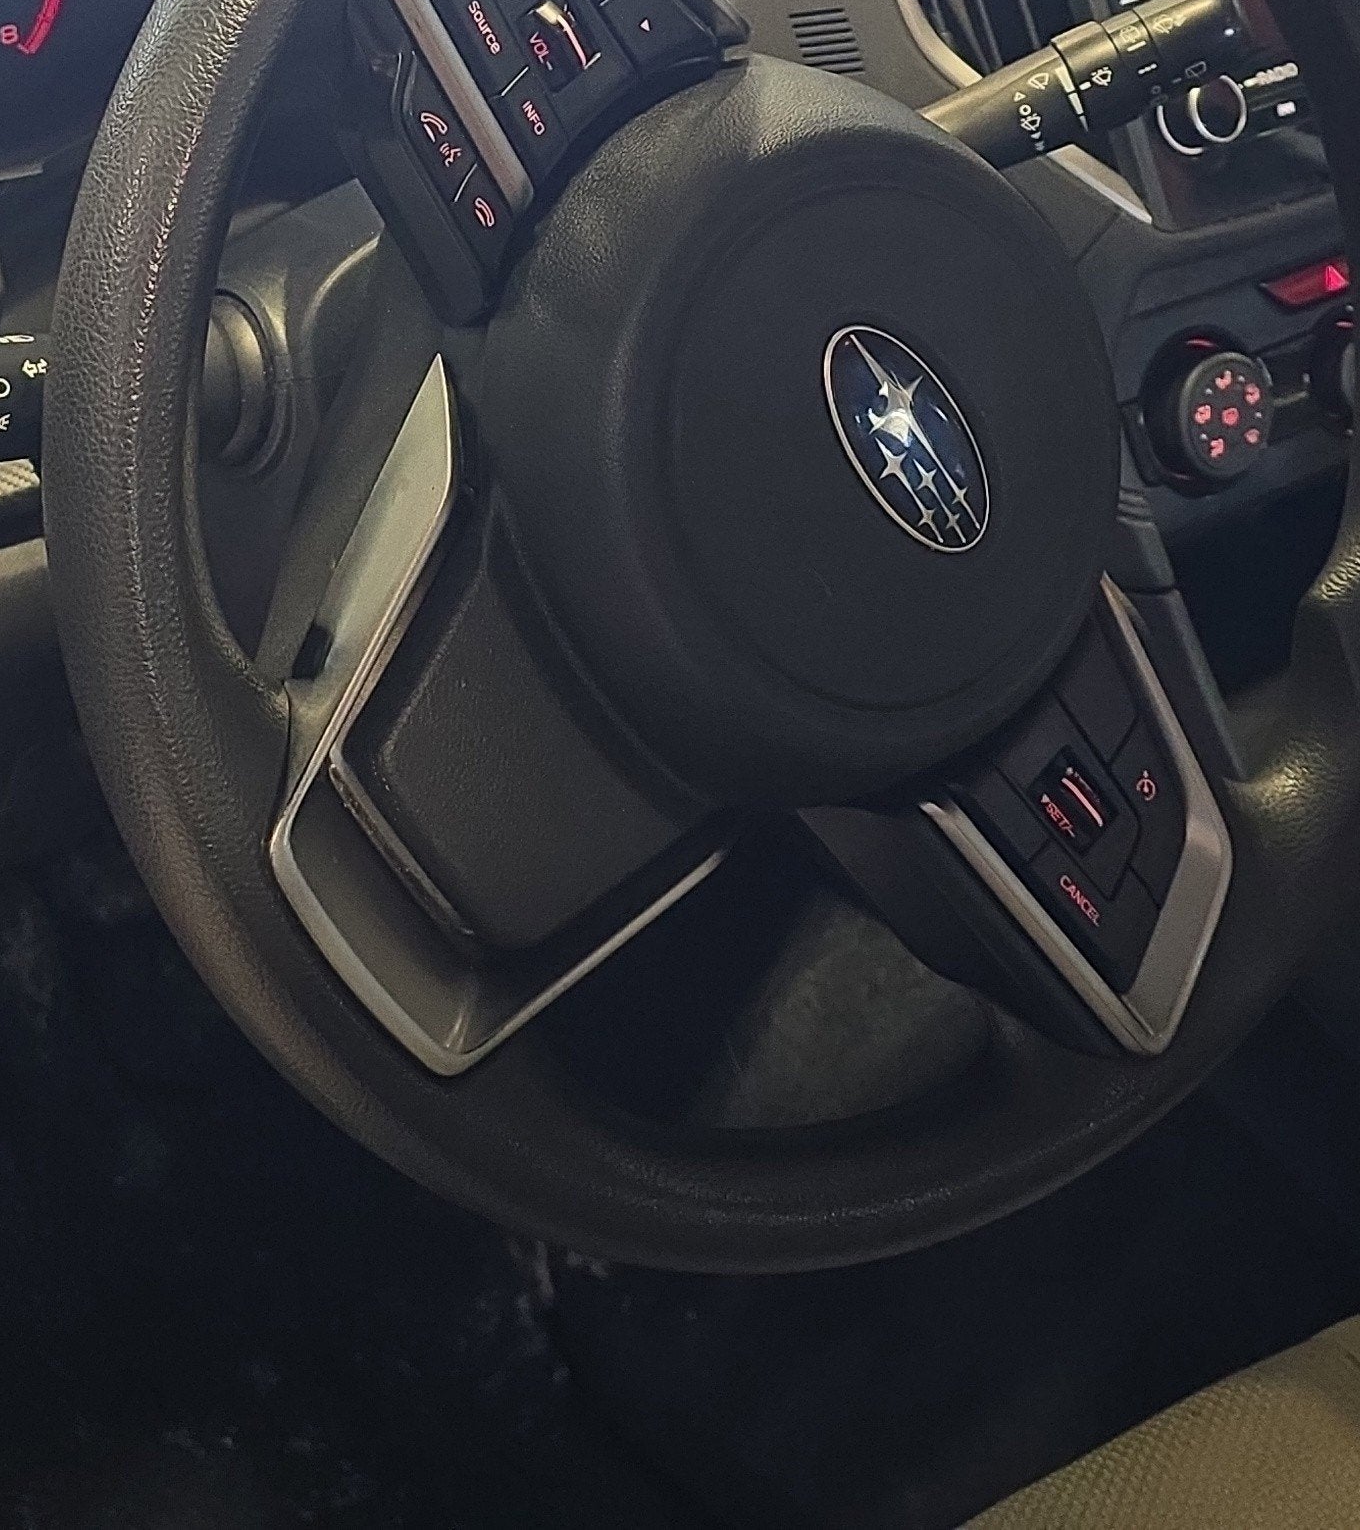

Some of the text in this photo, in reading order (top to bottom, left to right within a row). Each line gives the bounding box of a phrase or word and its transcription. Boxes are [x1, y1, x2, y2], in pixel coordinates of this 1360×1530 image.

[0, 24, 19, 45] 8
[521, 100, 546, 136] INFO
[1060, 874, 1100, 927] CANCEL
